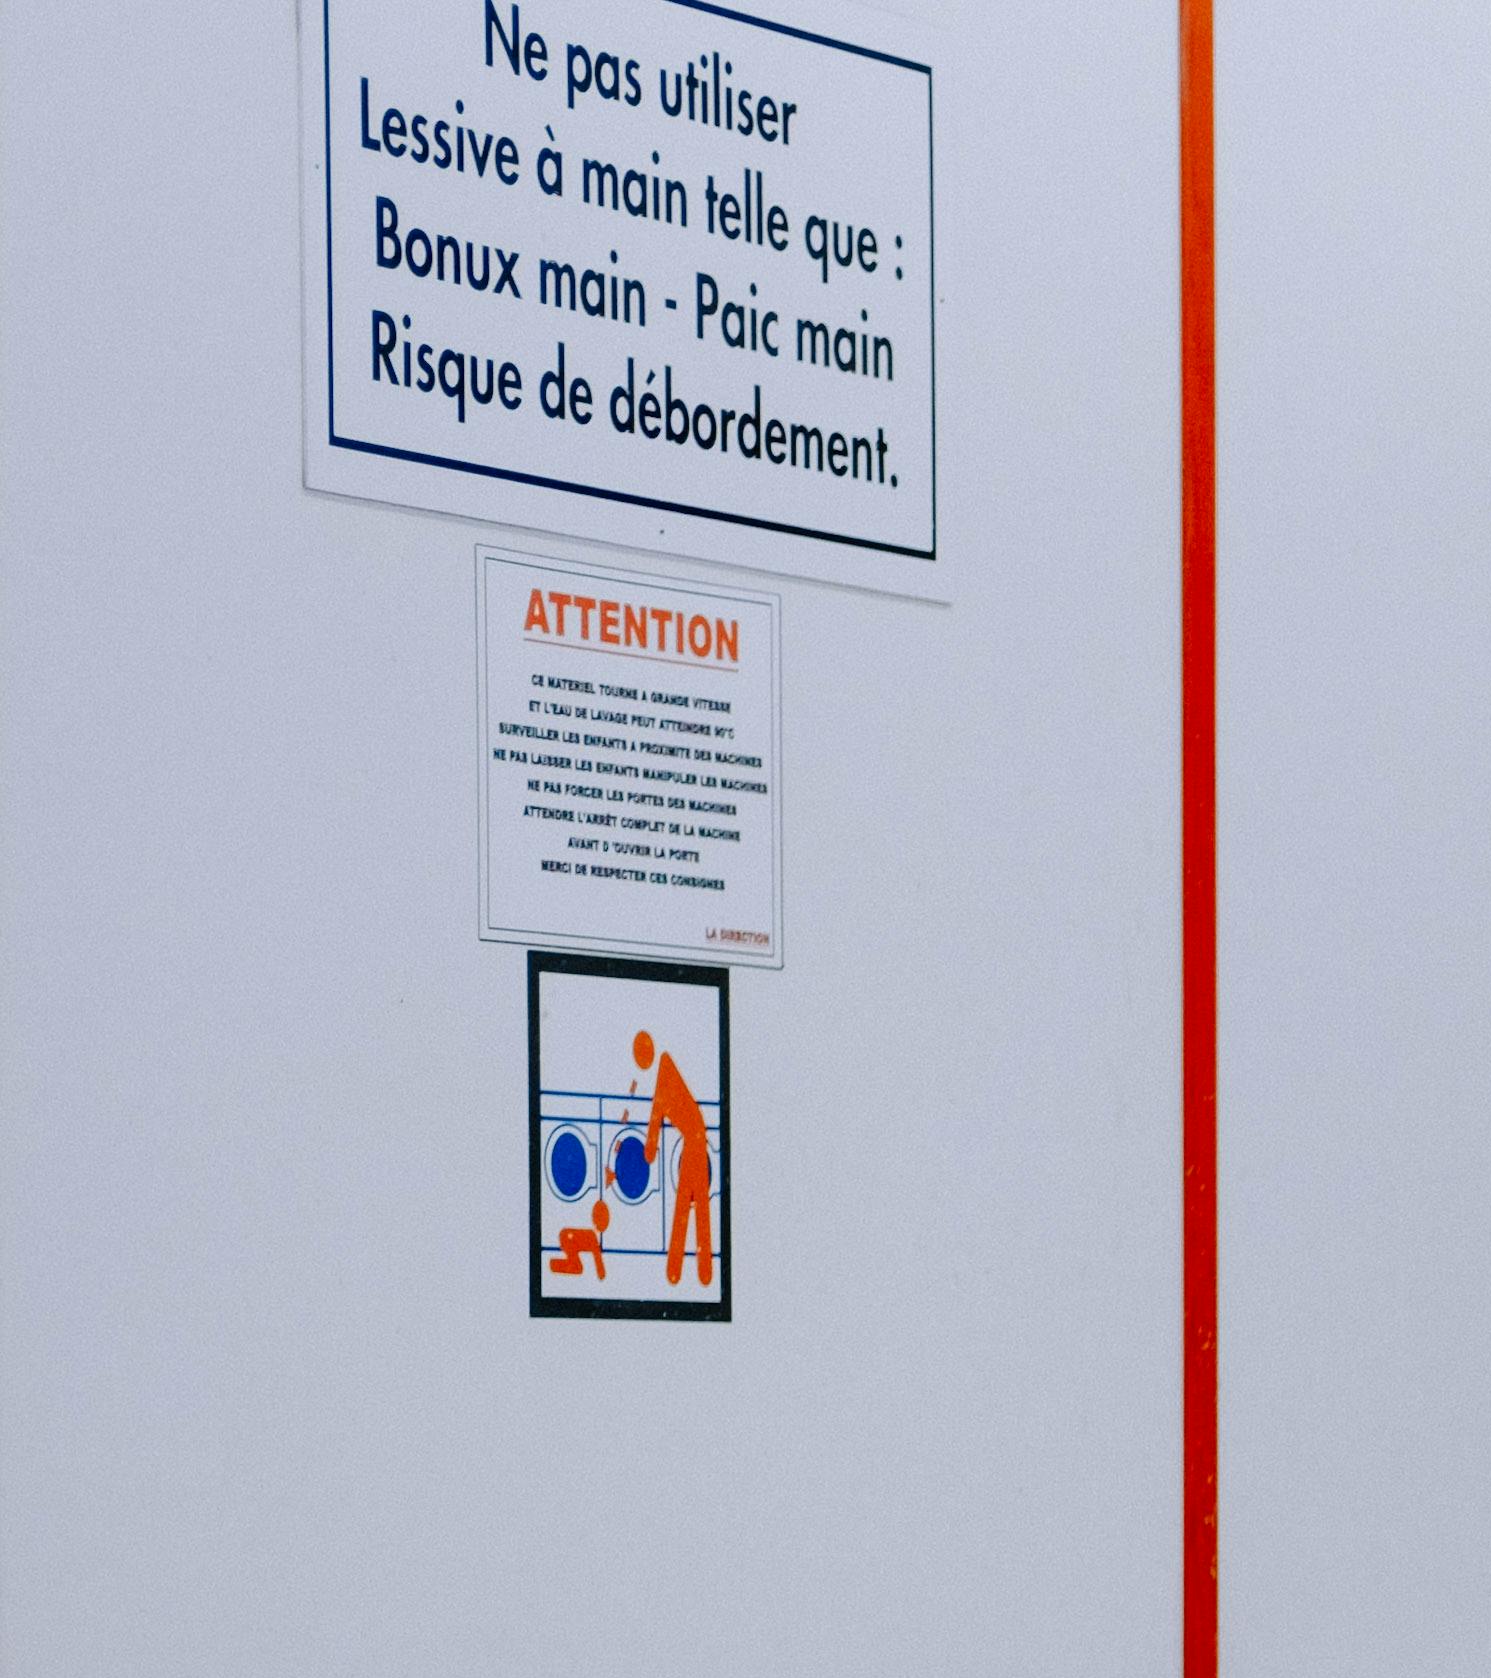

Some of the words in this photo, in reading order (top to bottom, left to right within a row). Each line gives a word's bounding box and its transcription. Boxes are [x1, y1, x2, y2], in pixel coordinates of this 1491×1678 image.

[484, 0, 549, 82] Ne
[566, 43, 642, 108] pas
[659, 53, 798, 146] utiliser
[360, 76, 520, 186] Lessive
[536, 124, 563, 197] à
[582, 150, 688, 228] main
[704, 169, 789, 252] telle
[804, 214, 878, 284] que
[895, 235, 904, 281] :
[375, 195, 522, 299] Bonux
[539, 249, 646, 327] main
[695, 271, 779, 358] Paic
[796, 309, 894, 381] main
[371, 309, 523, 424] Risque
[539, 341, 593, 426] de
[609, 356, 899, 488] débordement.
[523, 588, 739, 662] ATTENTION
